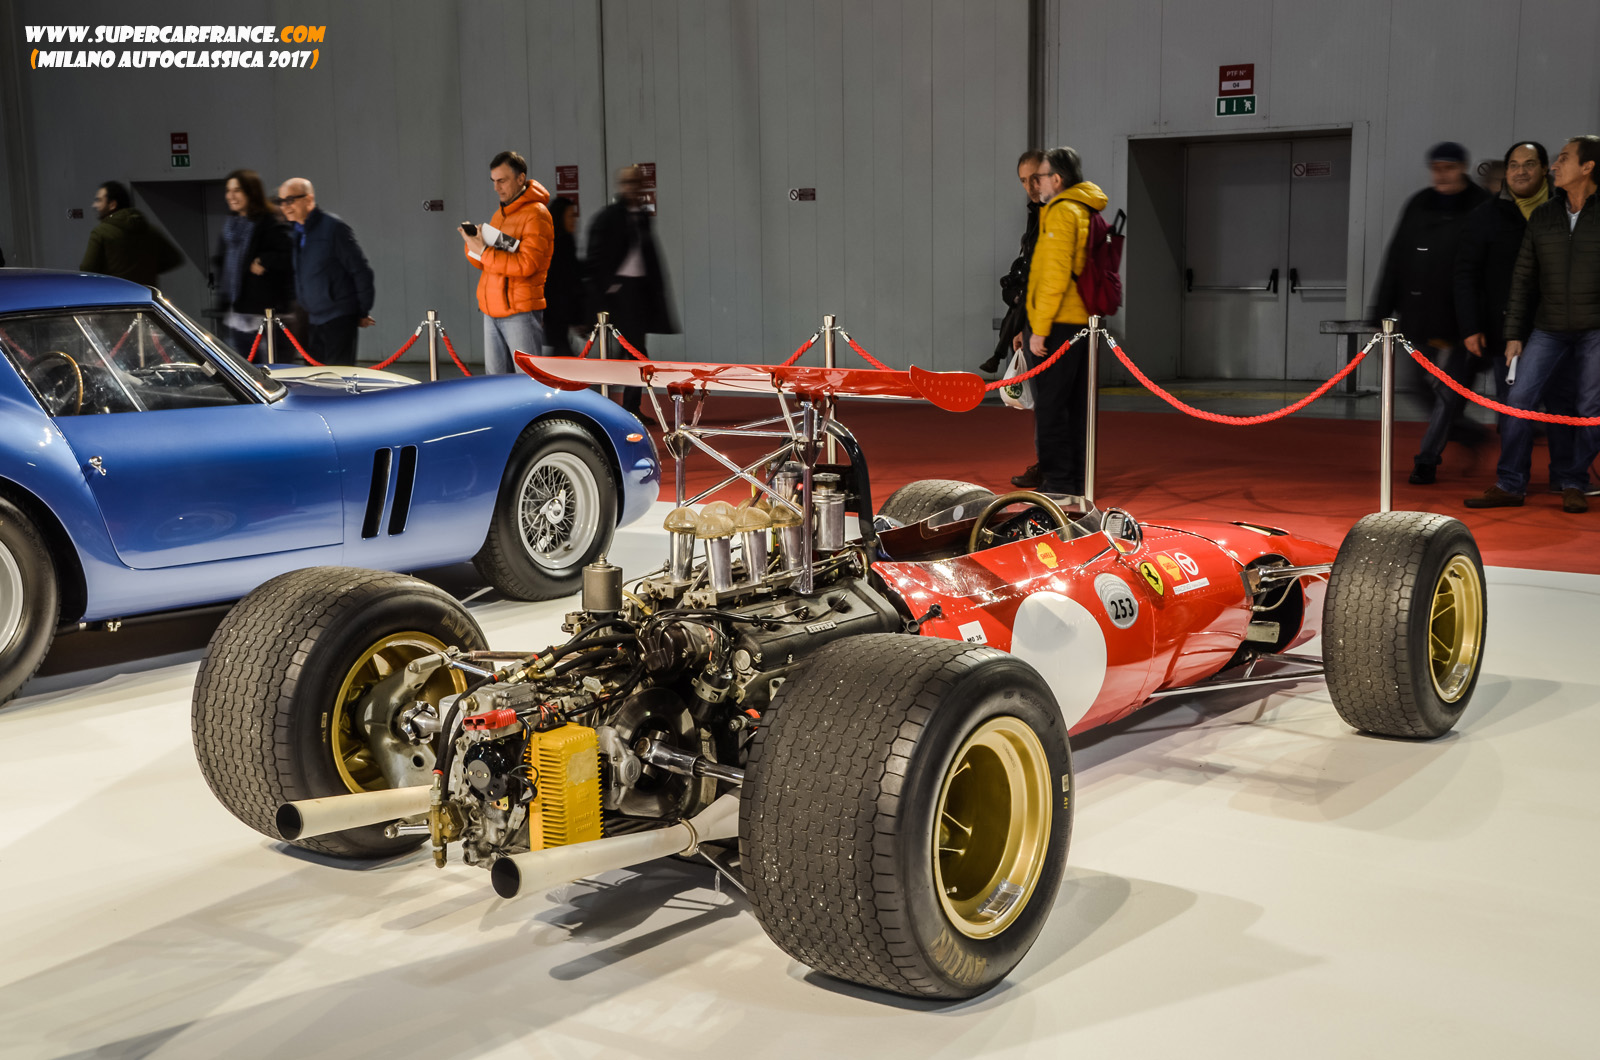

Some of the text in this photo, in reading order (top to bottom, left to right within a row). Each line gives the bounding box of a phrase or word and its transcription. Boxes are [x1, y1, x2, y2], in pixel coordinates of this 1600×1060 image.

[1226, 70, 1238, 78] PTF
[1110, 597, 1135, 620] 253
[930, 927, 988, 983] AVON
